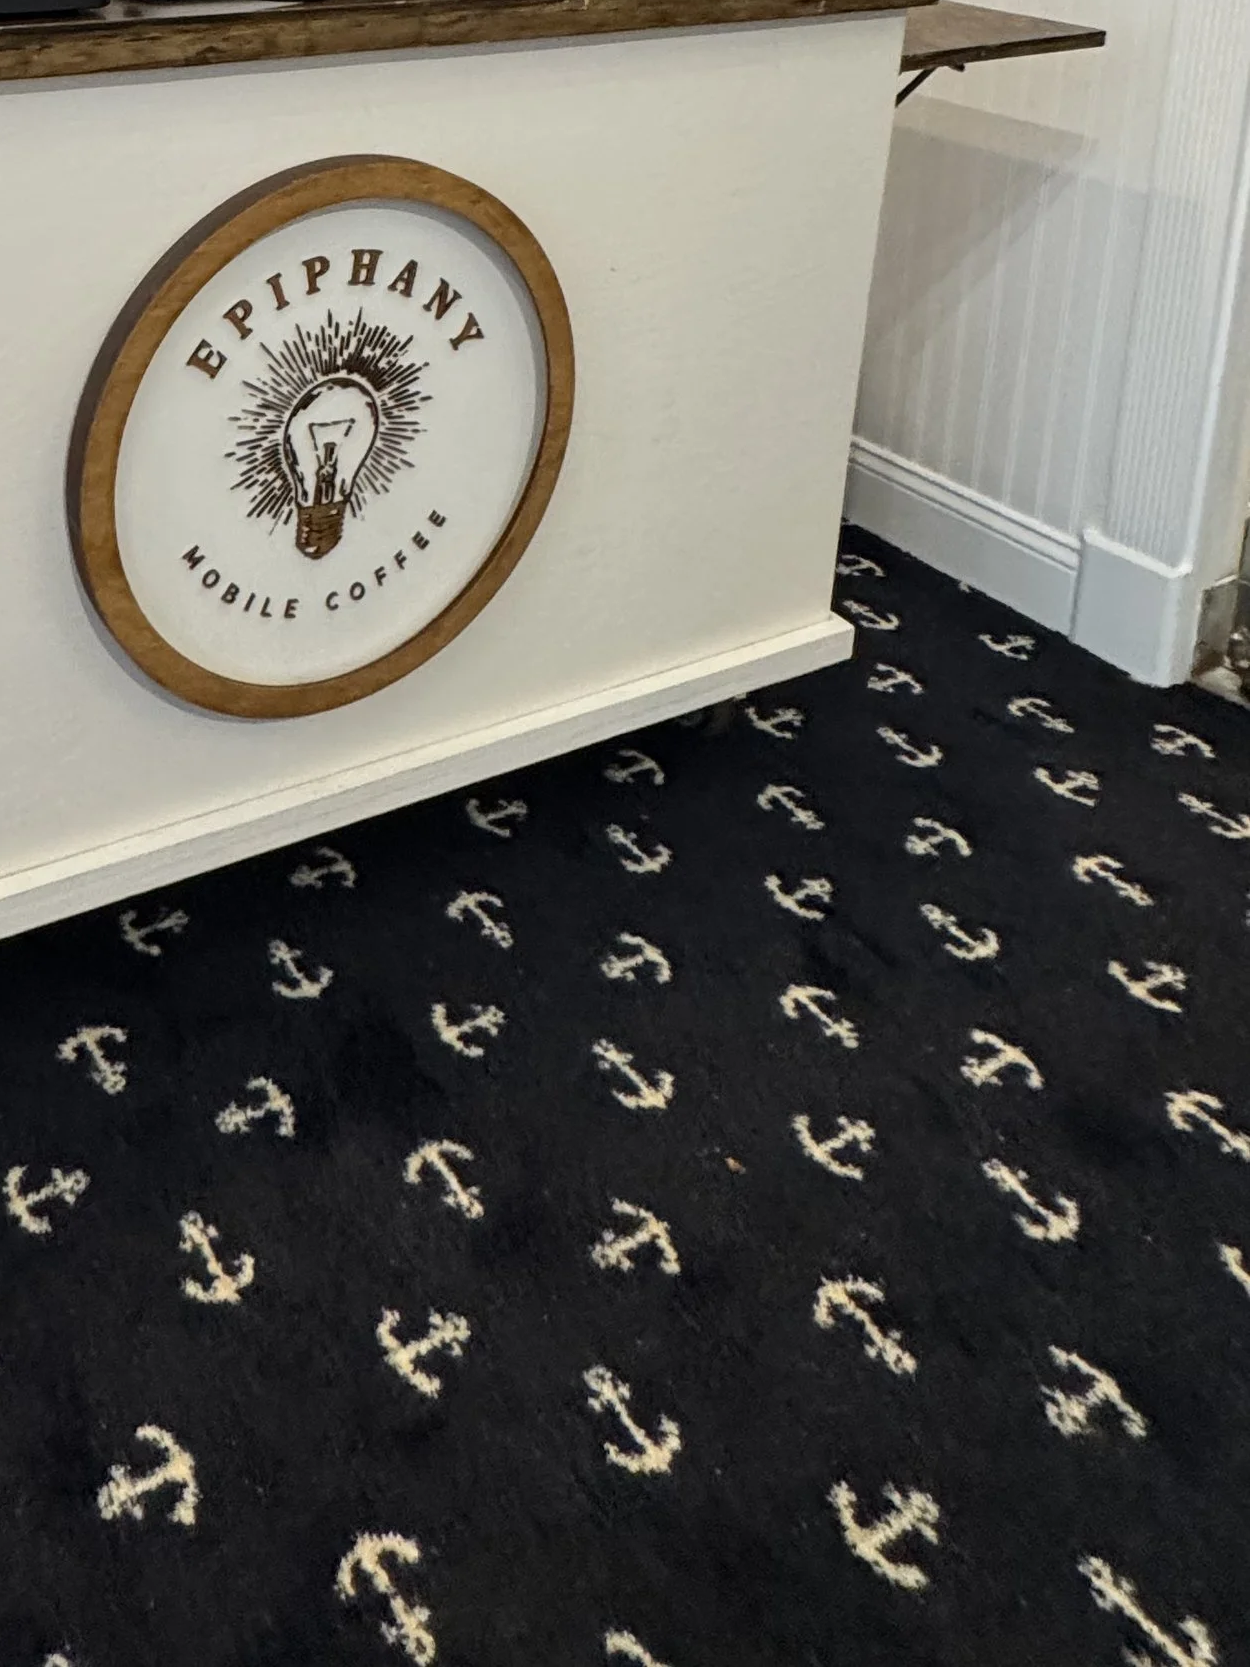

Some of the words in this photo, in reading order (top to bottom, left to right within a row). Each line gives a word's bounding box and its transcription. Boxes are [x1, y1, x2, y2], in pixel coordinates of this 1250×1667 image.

[185, 248, 485, 380] EPIPHANY
[181, 545, 299, 620] MOBILE
[325, 508, 447, 612] COFFEE
